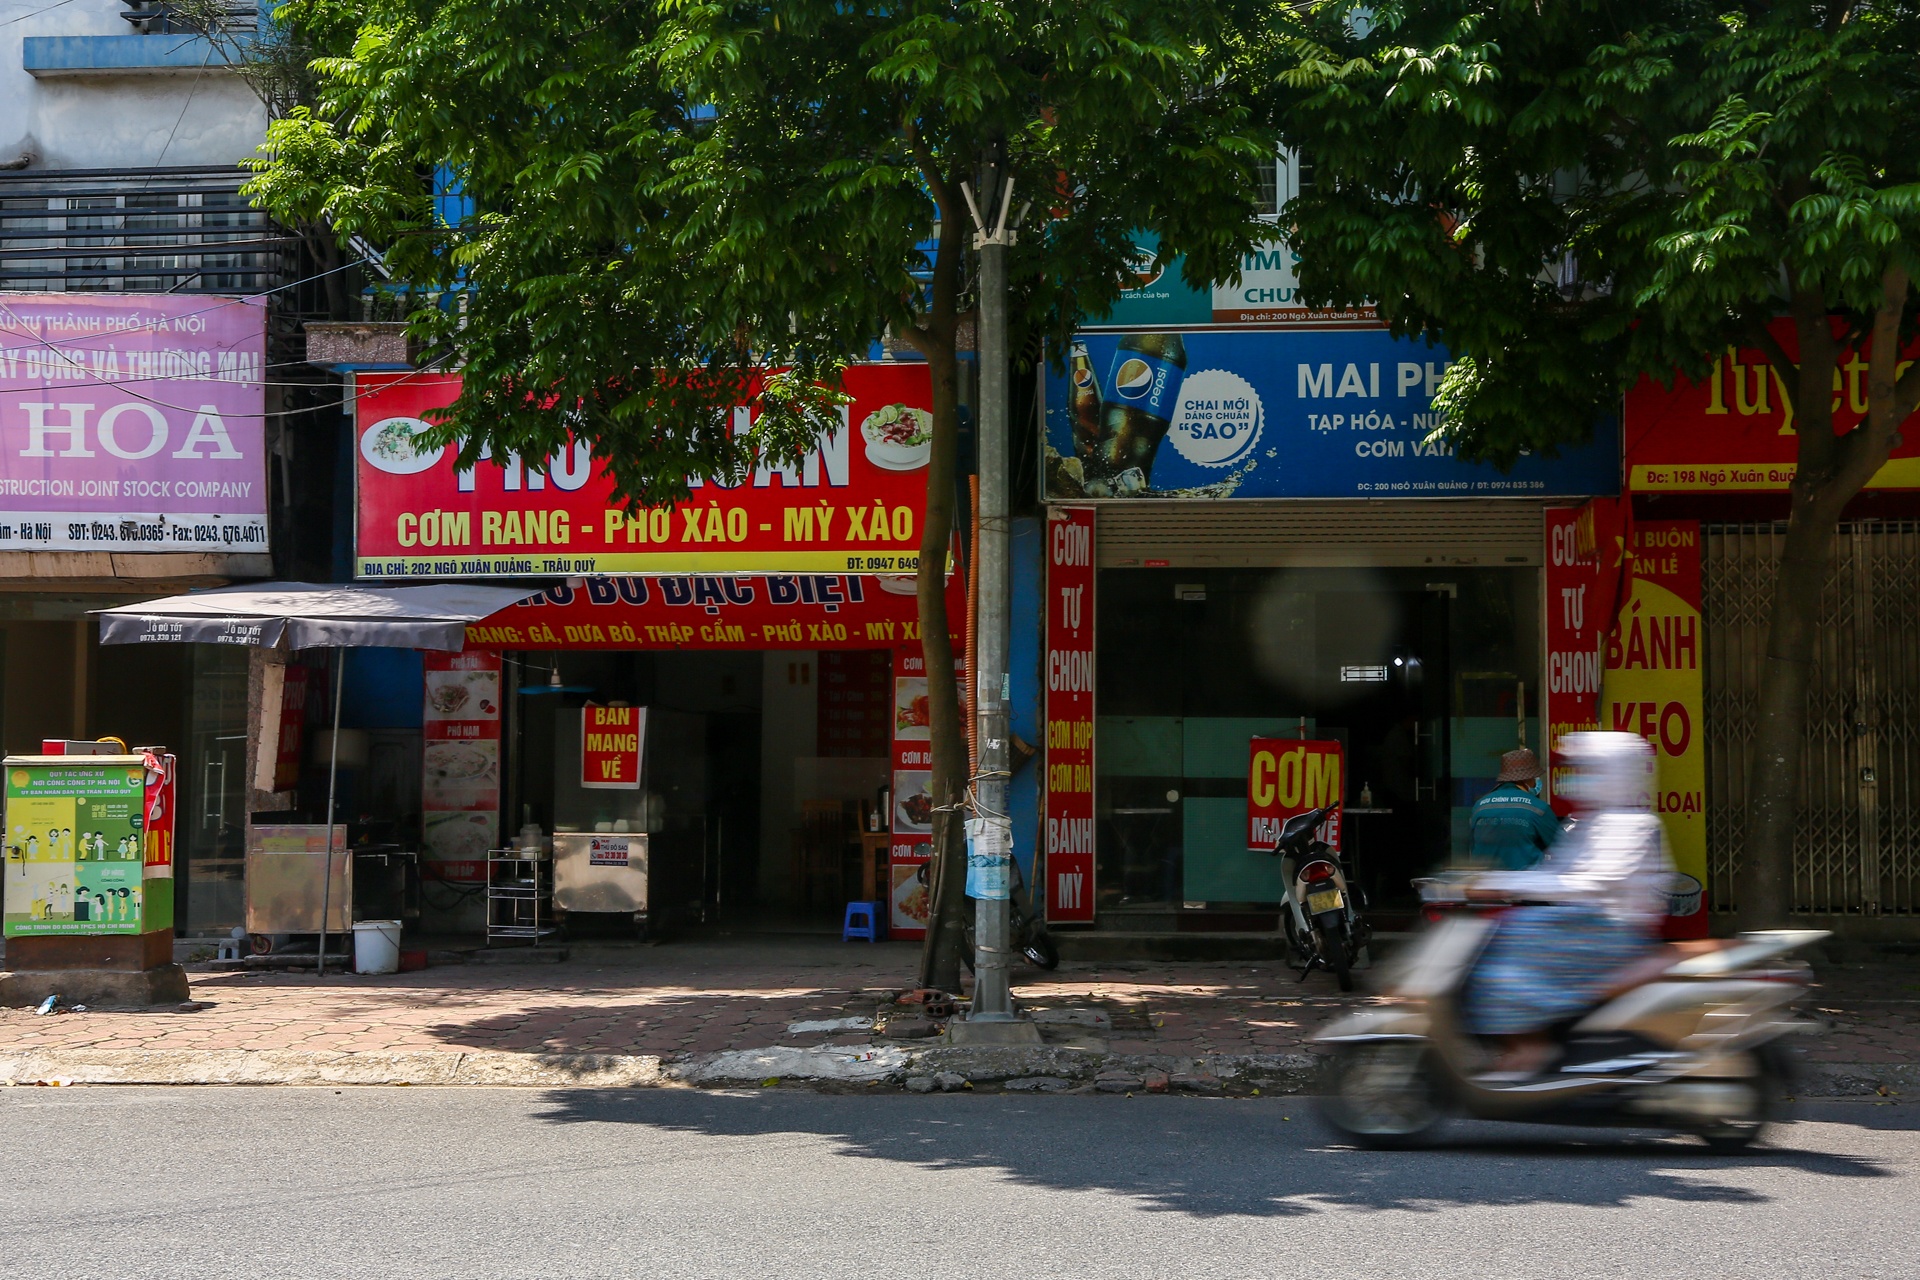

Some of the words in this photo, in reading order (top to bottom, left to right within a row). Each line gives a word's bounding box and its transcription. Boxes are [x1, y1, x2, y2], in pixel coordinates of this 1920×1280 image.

[22, 314, 41, 331] TƯ
[45, 311, 100, 332] THÀNH
[106, 312, 141, 332] PHỐ
[146, 313, 169, 333] HÀ
[174, 315, 206, 336] NỘI
[1240, 312, 1255, 322] Địa
[1272, 312, 1289, 320] 200
[1289, 312, 1306, 322] Ngô
[1307, 310, 1329, 320] Xuân
[1365, 310, 1378, 319] Trâ
[26, 347, 86, 386] DỰNG
[92, 344, 120, 381] VÀ
[126, 348, 213, 381] THƯƠNG
[217, 351, 259, 389] MẠI
[1149, 367, 1168, 407] pepsi
[1298, 362, 1380, 399] MAI
[1184, 400, 1219, 411] CHAI
[1223, 397, 1249, 411] MỚI
[1185, 410, 1213, 420] DÁNG
[19, 402, 243, 460] HOA
[1308, 413, 1345, 435] TẠP
[1350, 409, 1395, 431] HÓA
[1355, 439, 1404, 458] CƠM
[78, 480, 119, 497] JOINT
[123, 481, 171, 498] STOCK
[174, 481, 252, 498] COMPANY
[1357, 482, 1373, 491] ĐC:
[1374, 482, 1390, 491] 200
[1391, 480, 1411, 491] NGÔ
[1412, 480, 1436, 491] XUÂN
[1437, 480, 1468, 491] QUẢNG
[1477, 481, 1490, 490] ĐT:
[1491, 481, 1511, 490] 0974
[1512, 481, 1528, 490] 835
[1529, 481, 1545, 490] 386
[1647, 470, 1669, 484] Đc:
[1673, 470, 1696, 483] 198
[1700, 468, 1726, 486] Ngô
[1730, 468, 1764, 484] Xuân
[1768, 467, 1796, 484] Quả
[20, 522, 33, 540] Hà
[36, 522, 52, 544] Nội
[68, 523, 89, 541] SĐT:
[91, 522, 118, 541] 0243.
[173, 524, 192, 542] Fax:
[194, 525, 220, 542] 0243.
[223, 525, 266, 543] 676.4011
[397, 508, 470, 547] CƠM
[482, 510, 570, 545] RANG
[682, 500, 748, 543] XÀO
[783, 499, 835, 542] MỲ
[846, 498, 913, 541] XÀO
[1053, 521, 1090, 567] CƠM
[1645, 526, 1694, 548] BUÔN
[386, 558, 408, 576] CHỈ:
[411, 563, 431, 575] 202
[435, 561, 457, 575] NGÔ
[460, 559, 490, 575] XUÂN
[494, 557, 532, 574] QUẢNG
[542, 557, 571, 573] TRÂU
[574, 557, 596, 573] QUỲ
[847, 557, 864, 570] ĐT:
[867, 557, 894, 569] 0947
[1632, 554, 1656, 575] ÁN
[1661, 551, 1678, 575] LẺ
[1061, 583, 1084, 639] TỰ
[1561, 583, 1585, 639] TỰ
[465, 626, 526, 644] RANG:
[528, 622, 562, 645] GÀ,
[564, 624, 606, 644] DƯA
[608, 621, 643, 645] BÒ,
[644, 621, 695, 647] THẬP
[700, 618, 746, 643] CẨM
[762, 618, 803, 643] PHỞ
[807, 619, 847, 642] XÀO
[866, 618, 896, 641] MỲ
[1605, 598, 1697, 671] BÁNH
[903, 656, 923, 671] CƠM
[1049, 649, 1093, 702] CHỌN
[1550, 650, 1598, 703] CHỌN
[587, 733, 637, 753] MANG
[1048, 718, 1071, 750] CƠM
[1073, 715, 1093, 756] HỘP
[601, 753, 622, 779] VỀ
[901, 750, 921, 765] CƠM
[1049, 761, 1072, 793] CƠM
[1252, 746, 1340, 810] CƠM
[1657, 791, 1701, 820] LOẠI
[1048, 810, 1093, 854] BÁNH
[892, 843, 912, 858] CƠM
[1058, 865, 1083, 909] MỲ
